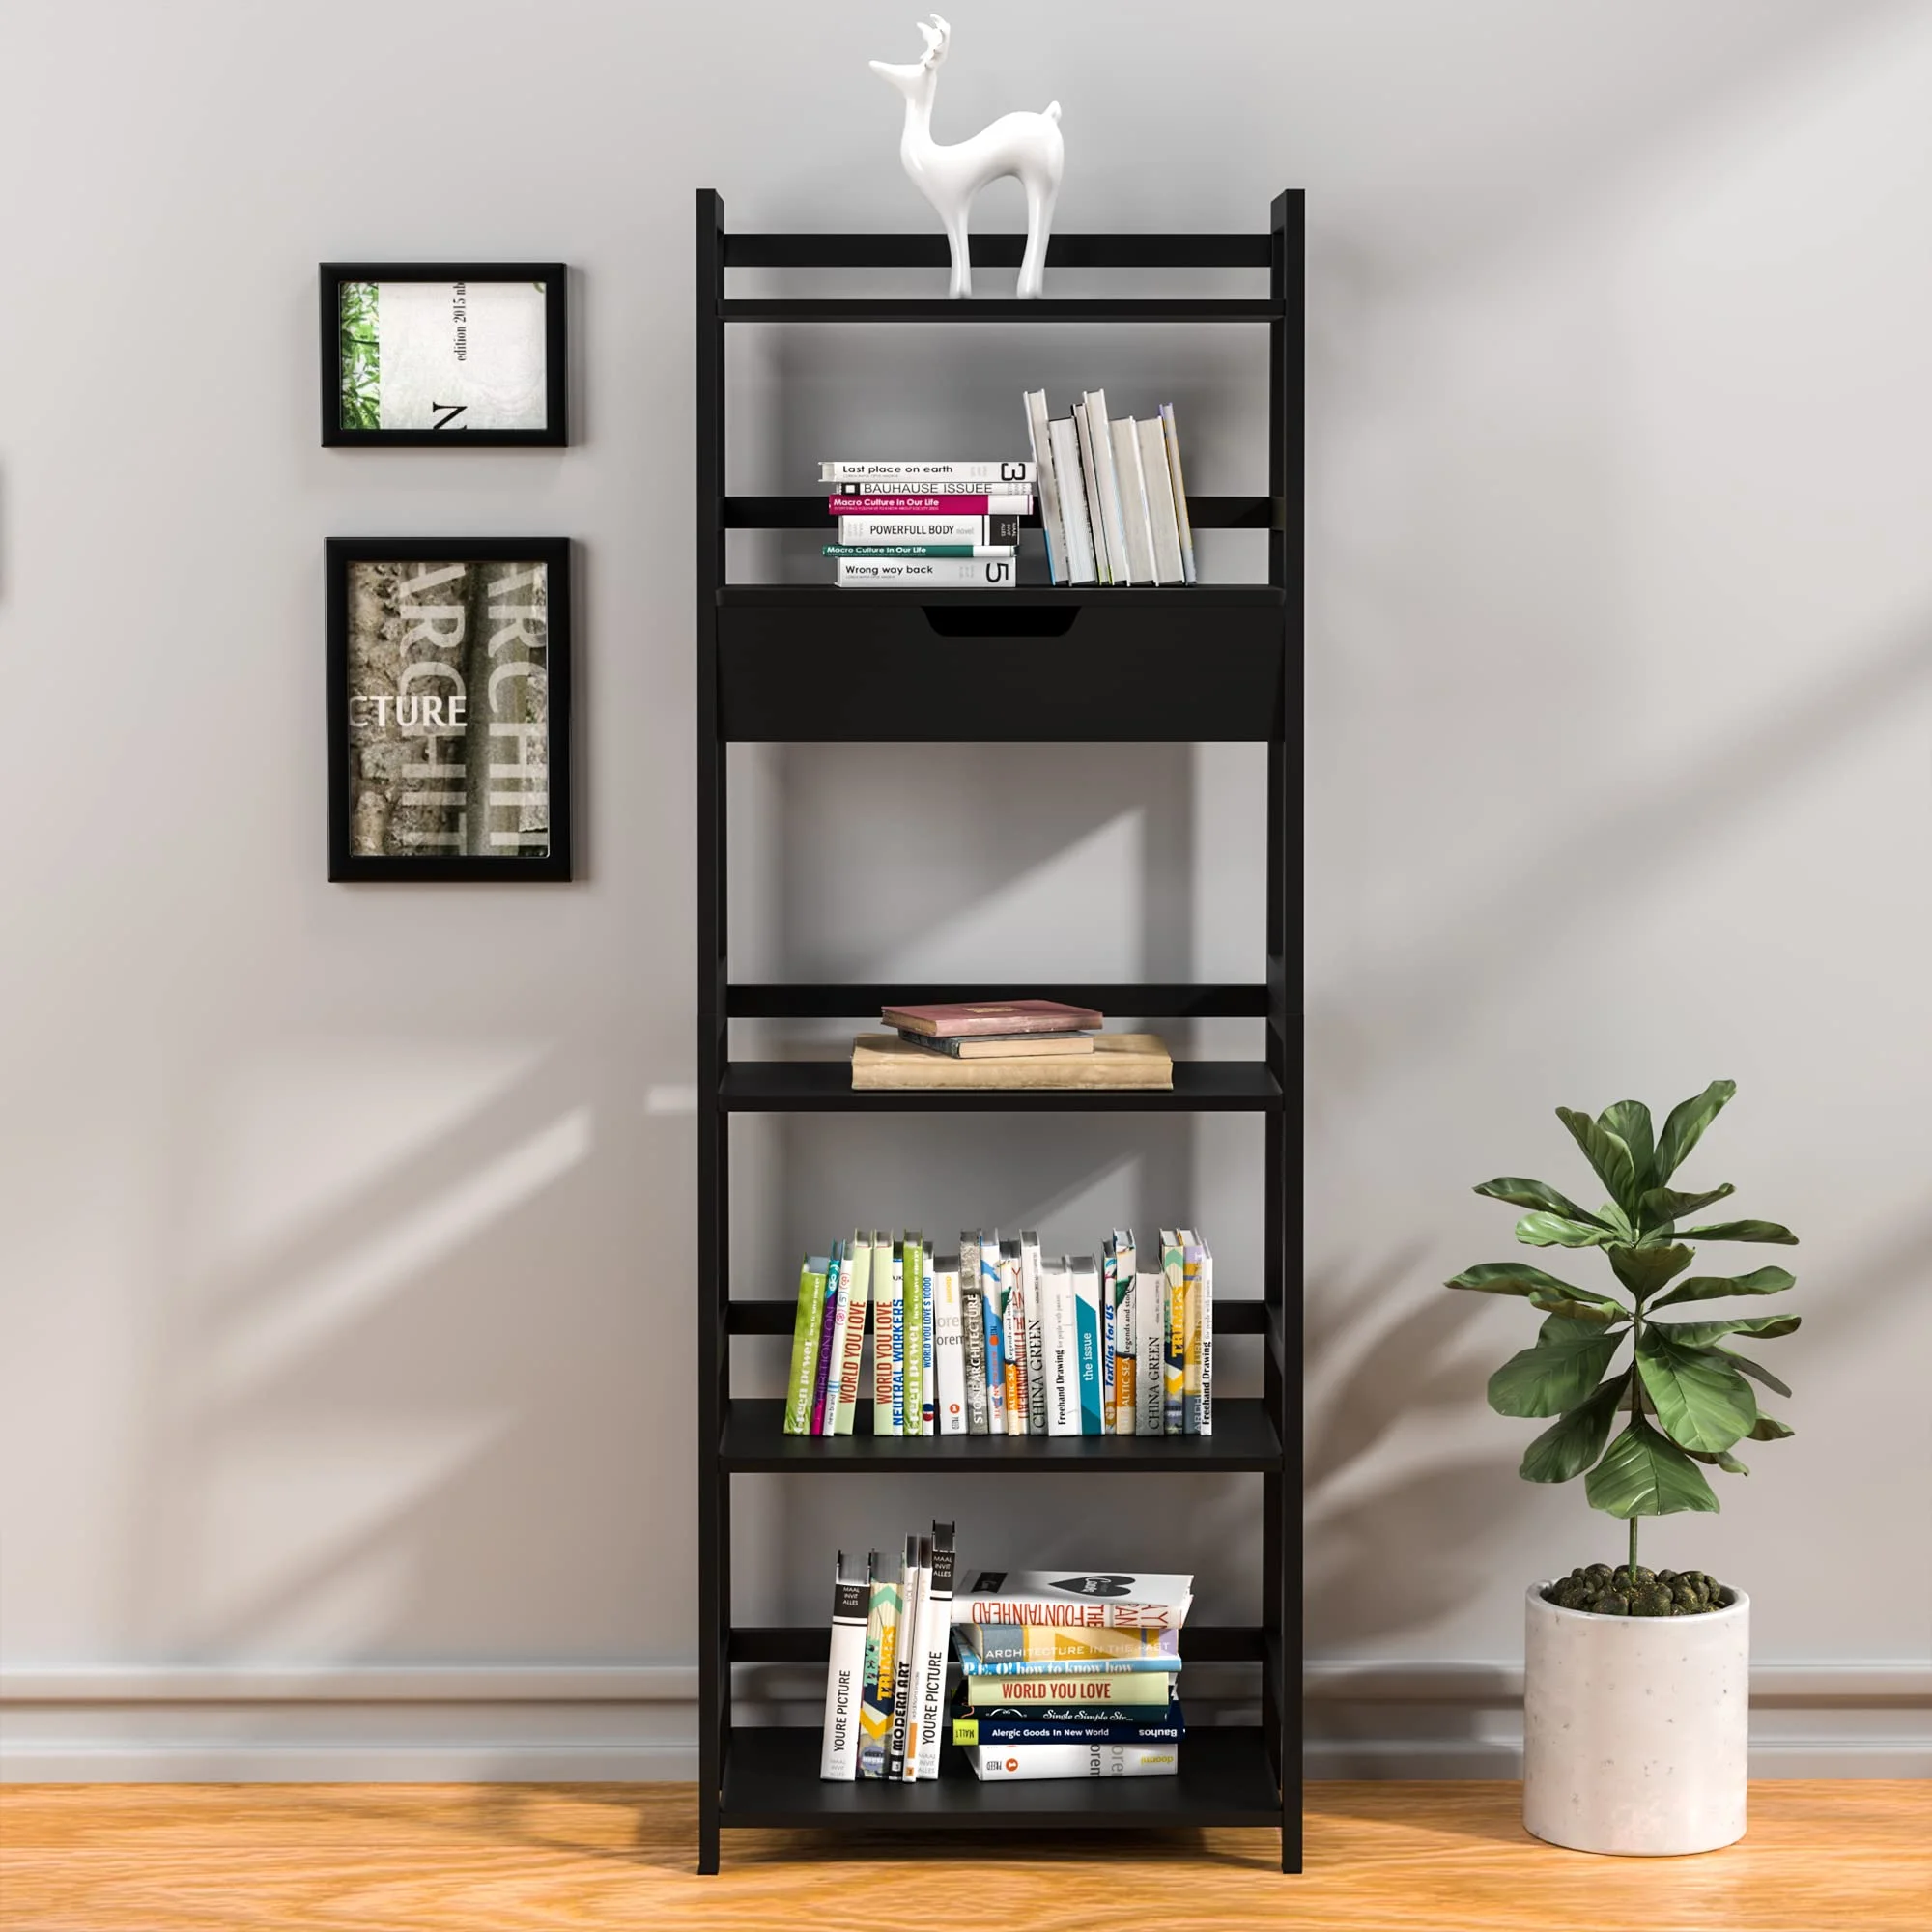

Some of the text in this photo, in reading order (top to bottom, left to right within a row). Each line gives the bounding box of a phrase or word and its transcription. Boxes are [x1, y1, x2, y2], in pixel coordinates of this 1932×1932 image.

[453, 298, 466, 323] 2015
[453, 327, 467, 361] edition
[842, 465, 865, 473] Last
[868, 465, 901, 476] place
[923, 465, 953, 473] earth
[1000, 462, 1026, 482] 3
[864, 483, 993, 494] BAUHAUSE ISSUEE
[870, 525, 927, 535] POWERFULL
[929, 525, 954, 535] BODY
[845, 565, 934, 576] Wrong way back
[985, 562, 1009, 583] 5
[923, 1277, 932, 1299] 10000
[824, 1306, 836, 1331] ON
[923, 1308, 932, 1325] LOVE
[923, 1326, 932, 1342] YOU
[1105, 1324, 1114, 1341] for
[1123, 1324, 1133, 1353] Legends
[839, 1300, 866, 1404] WORLD YOU LOVE
[876, 1301, 893, 1405] WORLD YOU LOVE
[893, 1299, 904, 1426] NEUTRAL WORKERS
[909, 1325, 920, 1378] power
[923, 1344, 932, 1368] WORLD
[967, 1293, 983, 1424] STONE ARCHITECTURE
[1083, 1332, 1094, 1381] the issue
[1105, 1345, 1114, 1387] Textiles
[1148, 1336, 1159, 1380] GREEN
[1202, 1341, 1211, 1379] Drawing
[815, 1335, 834, 1420] HIBITION
[1028, 1319, 1046, 1428] CHINA GREEN
[1055, 1350, 1065, 1385] Drawing
[1122, 1357, 1131, 1377] SEA
[908, 1381, 920, 1434] Green
[1057, 1386, 1066, 1426] Freehand
[1122, 1378, 1130, 1408] ALTIC
[1149, 1384, 1159, 1430] CHINA
[1202, 1382, 1210, 1425] Freehand
[972, 1602, 1085, 1627] FOUNTAINHEAD
[1087, 1605, 1104, 1627] THE
[863, 1637, 880, 1687] TEXT
[985, 1646, 1085, 1659] ARCHITECTURE
[1089, 1645, 1103, 1654] IN
[1109, 1644, 1133, 1653] THE
[897, 1661, 910, 1688] ART
[1017, 1662, 1042, 1675] how
[1048, 1662, 1060, 1674] to
[1065, 1661, 1100, 1674] know
[1105, 1661, 1133, 1672] how
[837, 1669, 851, 1715] PICTURE
[922, 1651, 942, 1745] YOURE PICTURE
[1002, 1683, 1111, 1699] WORLD YOU LOVE
[893, 1691, 907, 1752] MODERN
[1043, 1709, 1073, 1720] Single
[1074, 1710, 1108, 1722] Simple
[833, 1717, 847, 1752] YOURE
[992, 1729, 1021, 1739] Alergic
[1085, 1728, 1110, 1737] World
[1138, 1728, 1178, 1738] Bauhos
